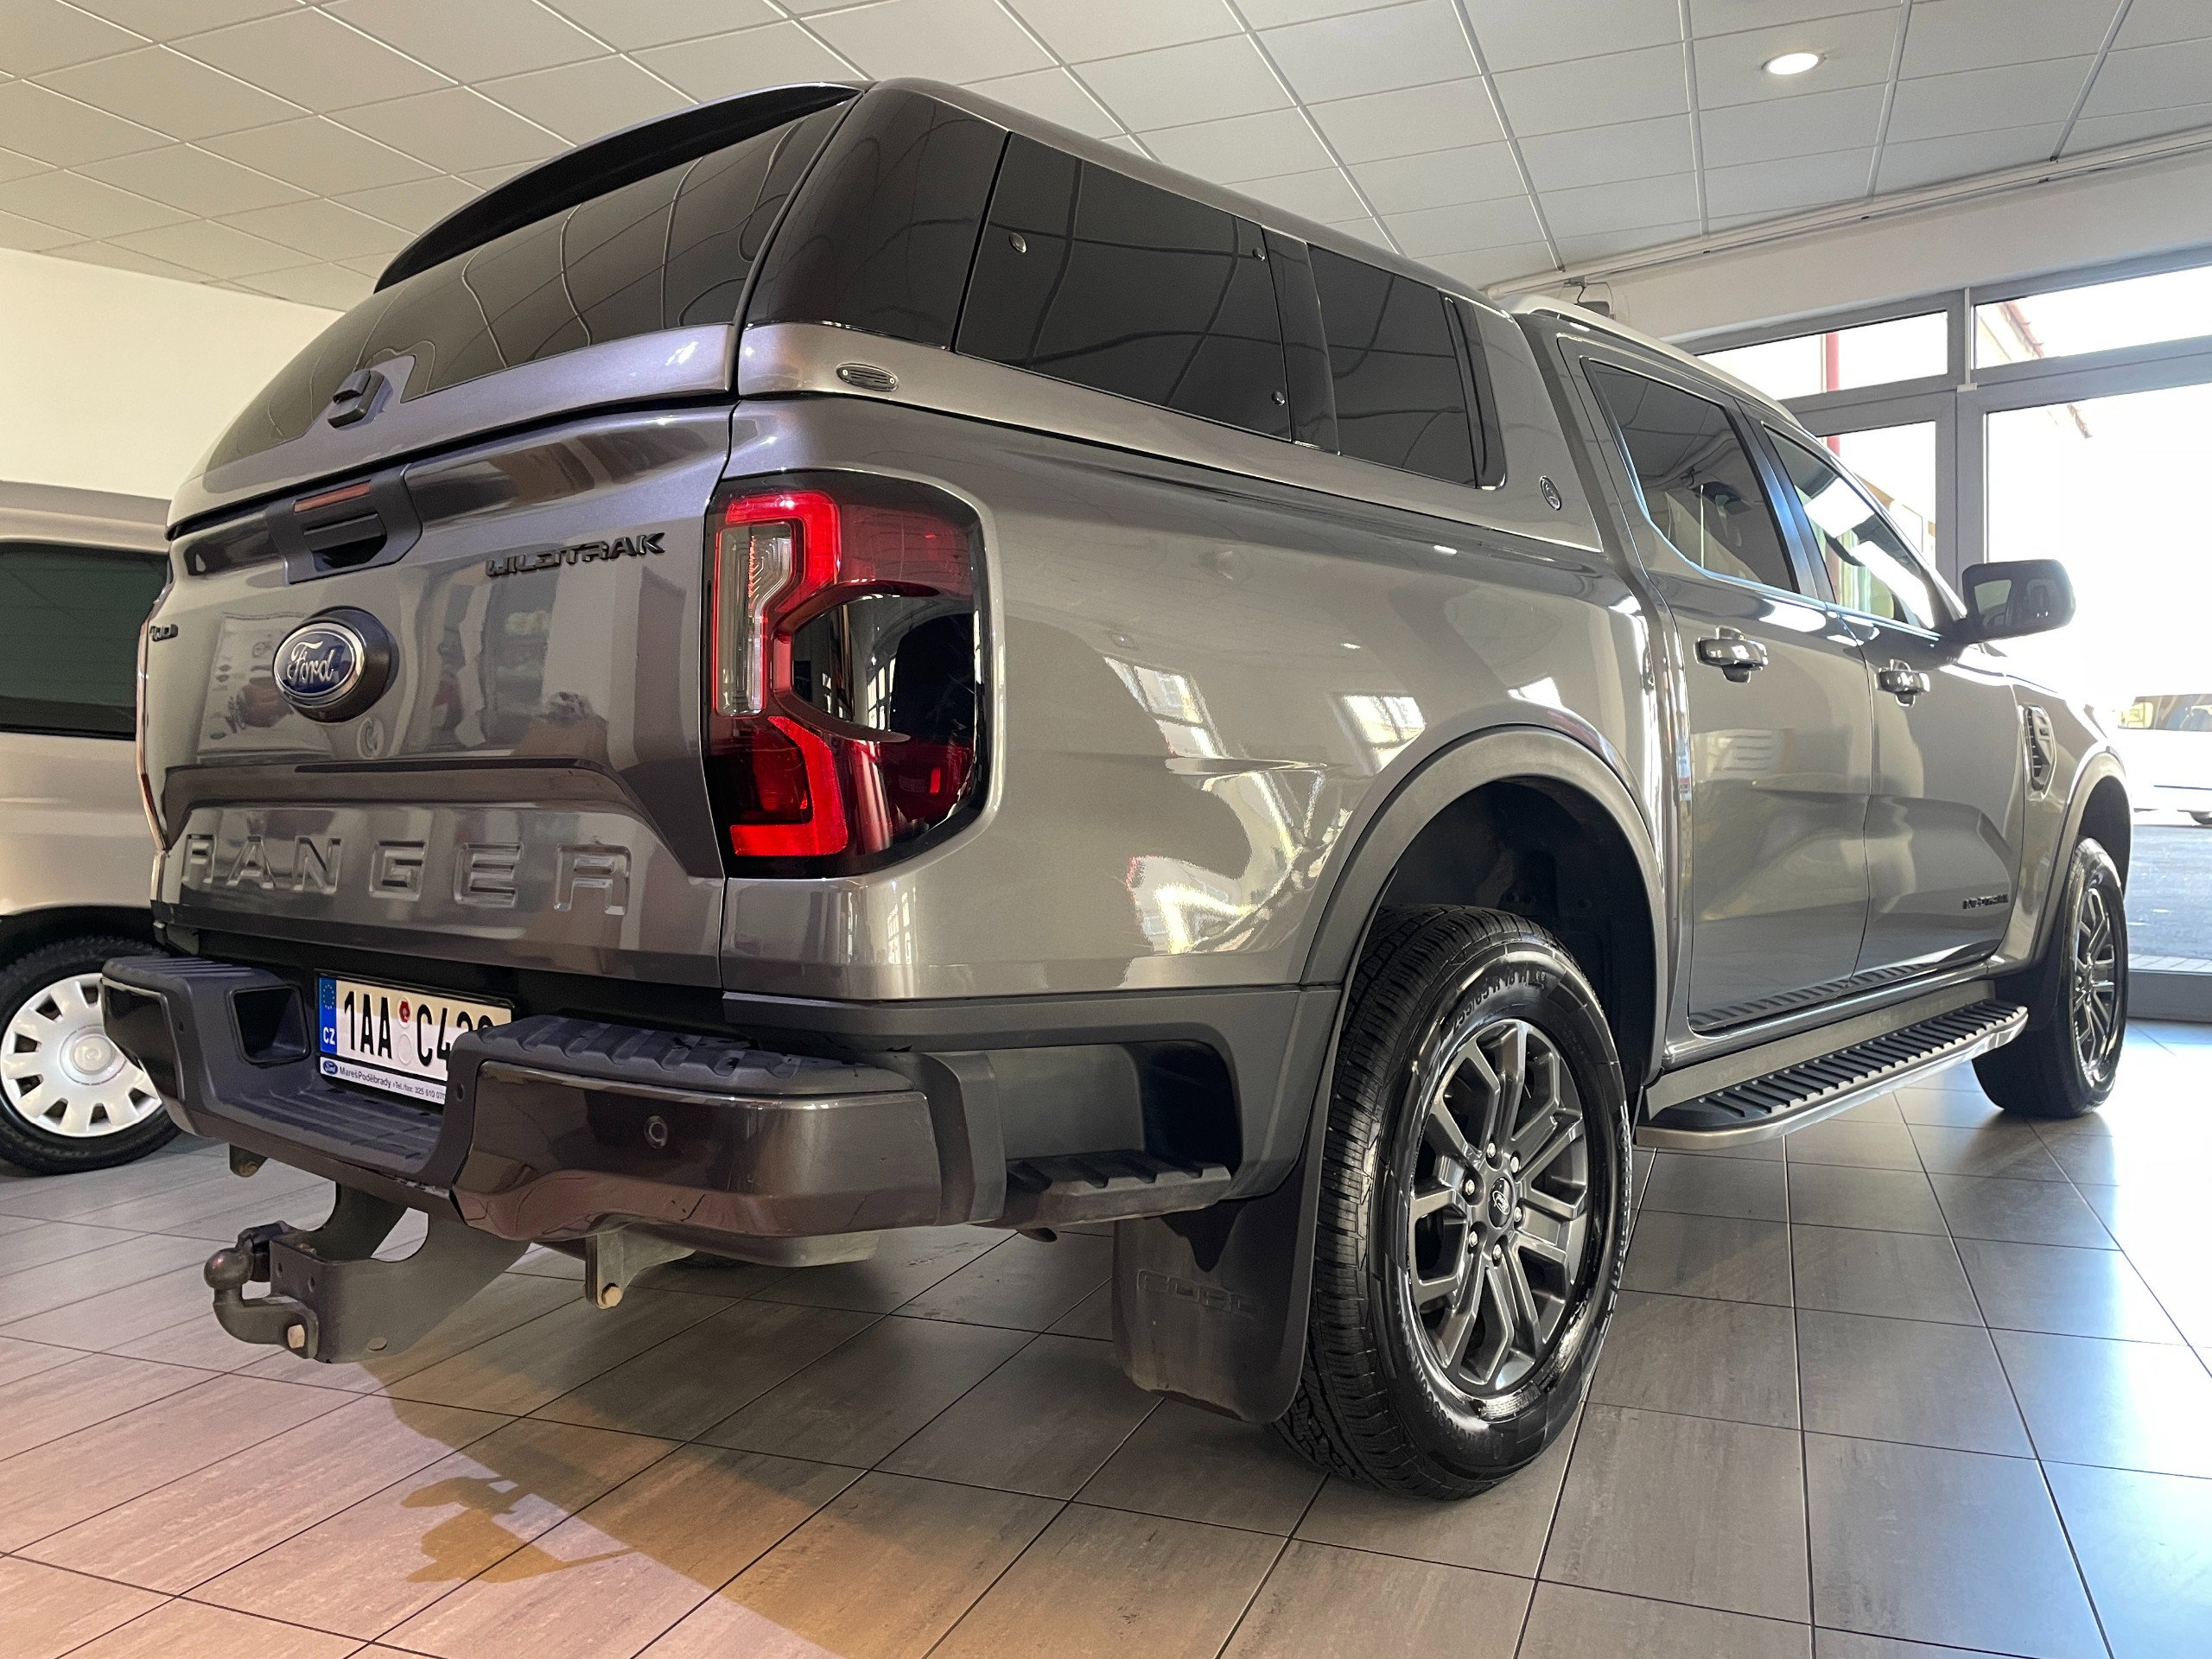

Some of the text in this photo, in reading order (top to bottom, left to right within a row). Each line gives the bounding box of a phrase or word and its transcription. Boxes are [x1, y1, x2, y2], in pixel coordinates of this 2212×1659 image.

[486, 532, 665, 577] WILDTRAK
[287, 640, 334, 685] Ford
[181, 833, 633, 918] RANGER
[323, 1027, 336, 1046] CZ
[345, 990, 493, 1067] 1AA C4
